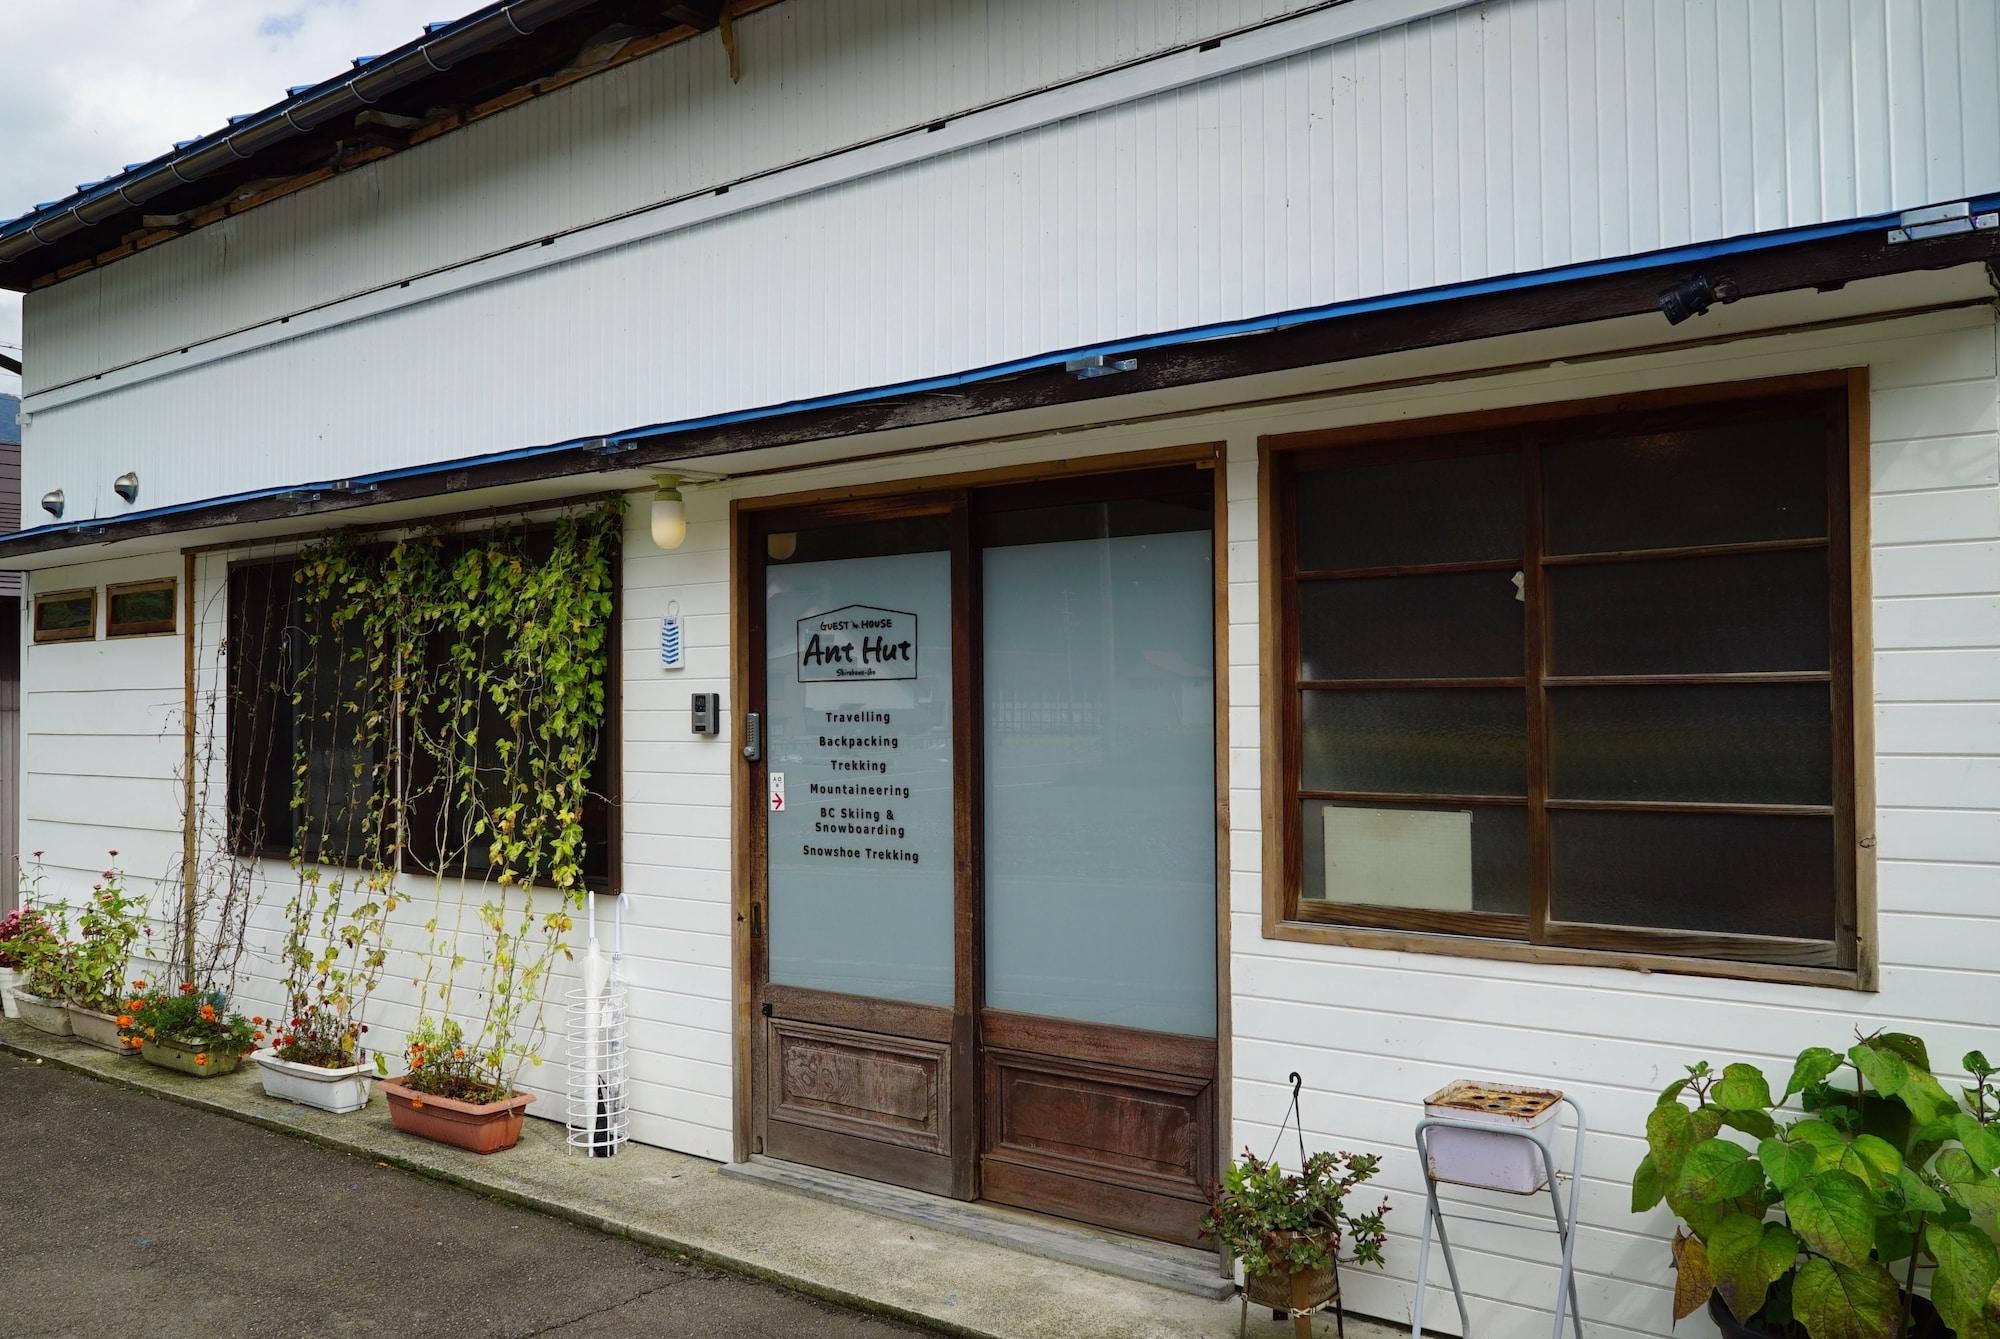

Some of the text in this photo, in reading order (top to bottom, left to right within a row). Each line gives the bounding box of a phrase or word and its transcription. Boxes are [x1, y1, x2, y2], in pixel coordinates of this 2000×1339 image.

[820, 620, 849, 631] GUEST
[861, 618, 892, 630] HOUSE
[803, 634, 911, 666] Ant Hut
[826, 712, 890, 724] Travelling
[819, 736, 898, 749] Backpacking
[830, 760, 886, 773] Trekking
[810, 784, 909, 799] Mountaineering
[820, 808, 895, 822] BC Skiing &
[815, 822, 904, 839] Snowboarding
[803, 845, 919, 864] Snowshoe Trekking
